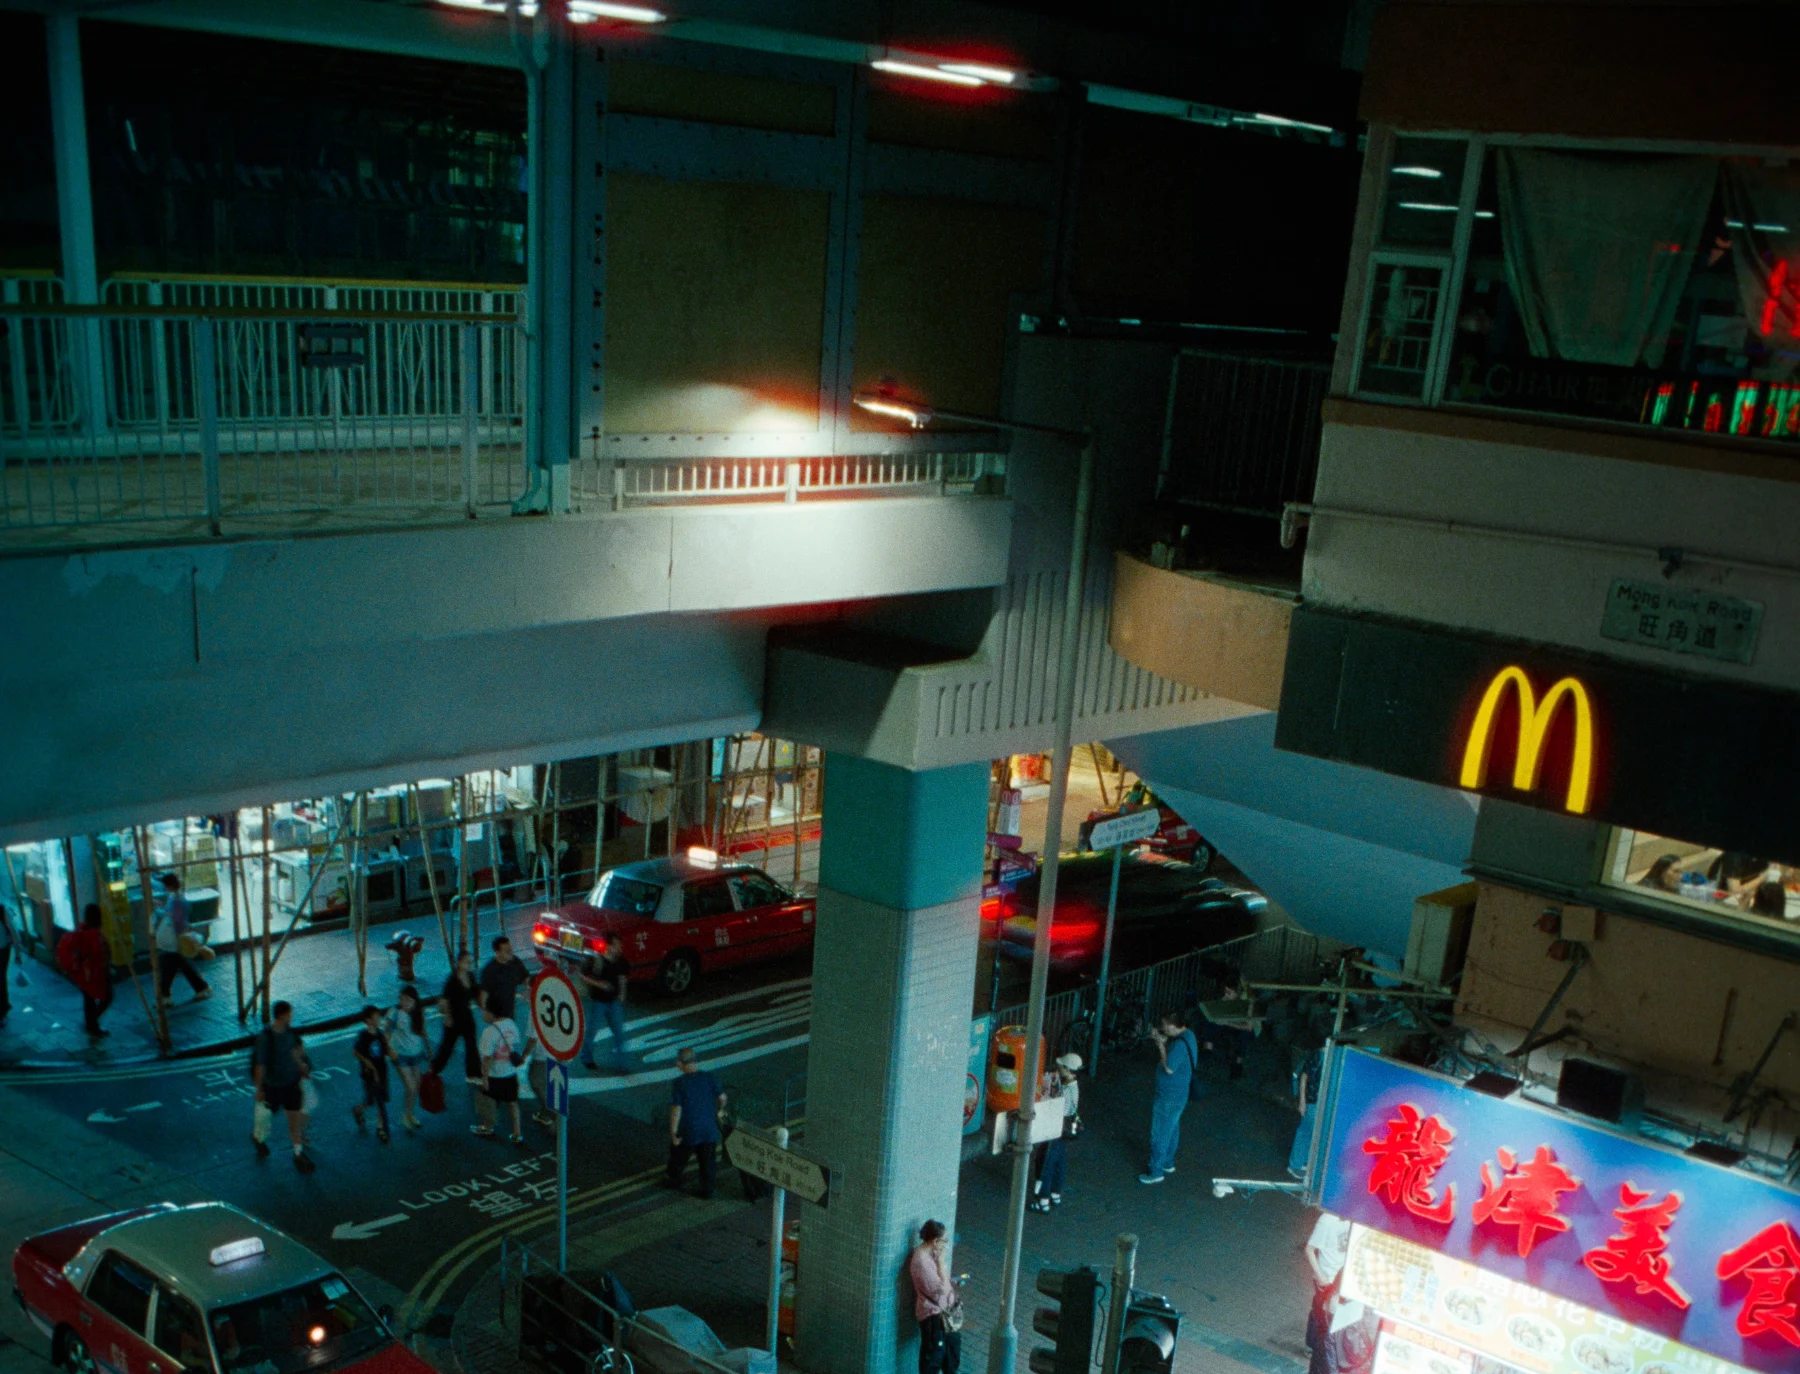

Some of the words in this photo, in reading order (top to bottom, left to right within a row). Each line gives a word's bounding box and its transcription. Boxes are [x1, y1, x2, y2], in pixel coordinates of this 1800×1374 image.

[1617, 586, 1661, 610] Mong
[1706, 600, 1753, 622] Road
[1638, 614, 1717, 649] 旺角道
[540, 993, 574, 1036] 30
[398, 1178, 492, 1211] LOOK
[484, 1152, 558, 1184] LEFT
[786, 1157, 809, 1176] Road
[469, 1178, 579, 1219] 望左
[1363, 1102, 1800, 1348] 龍津美食
